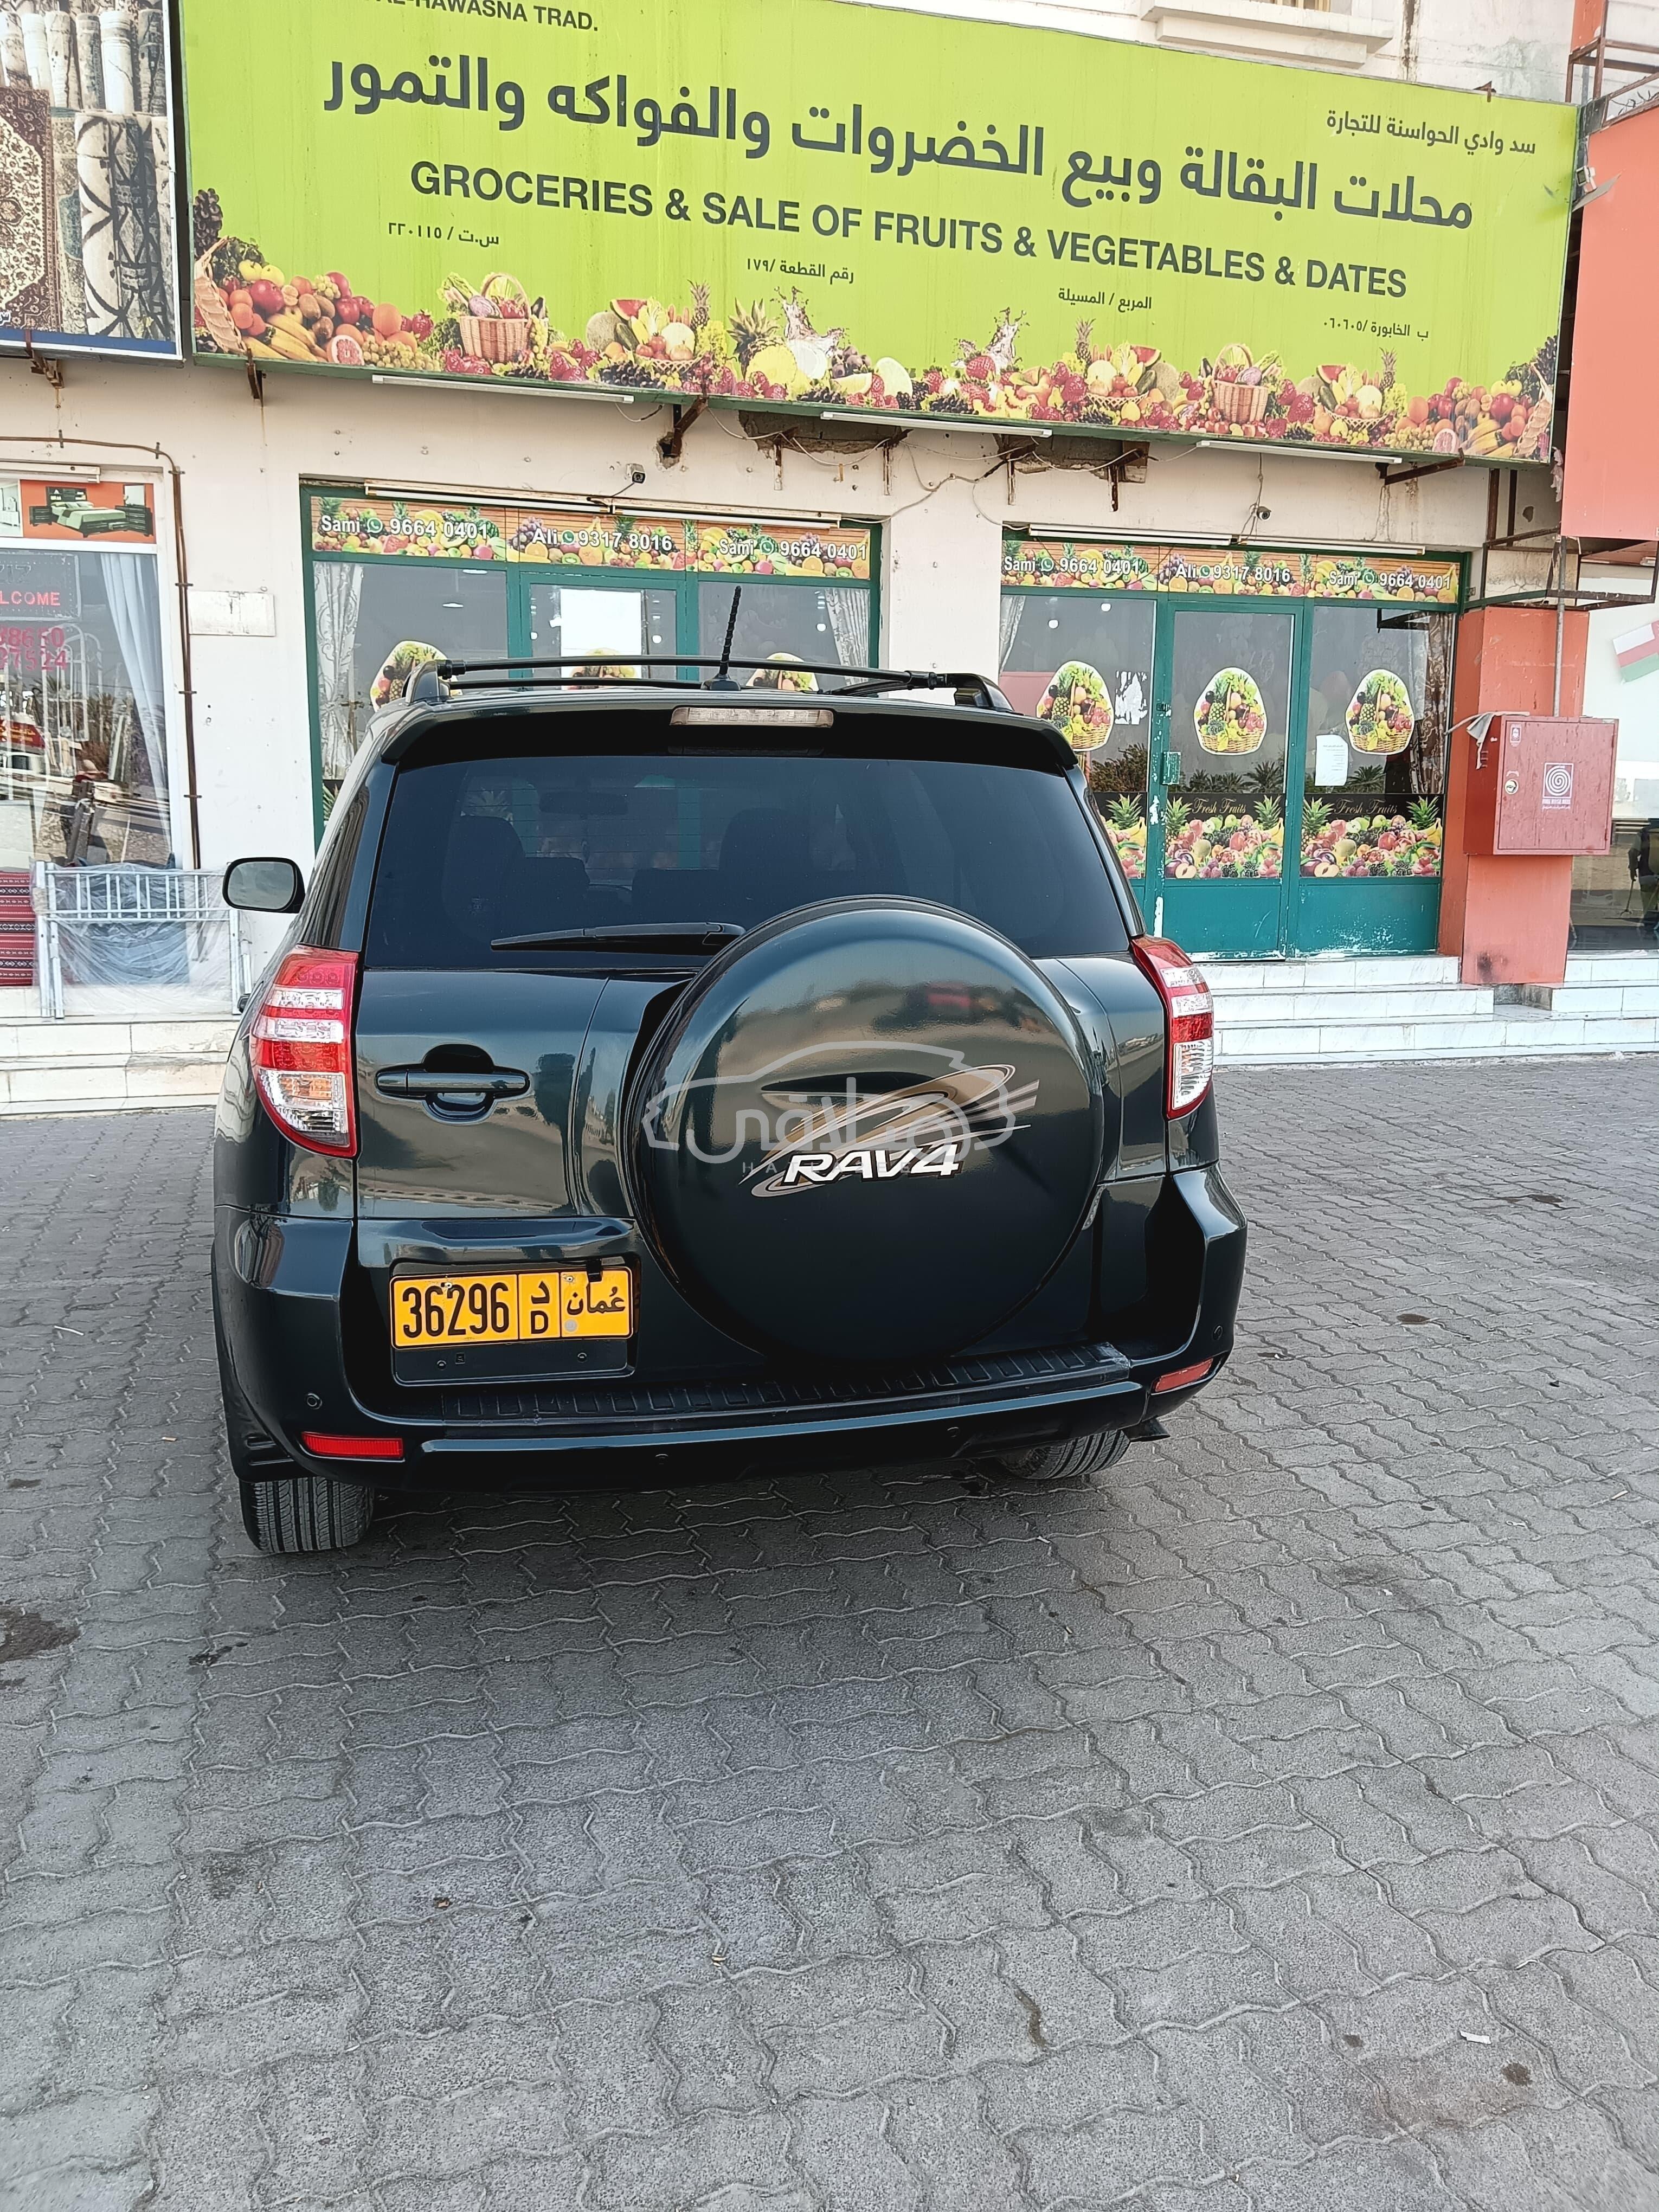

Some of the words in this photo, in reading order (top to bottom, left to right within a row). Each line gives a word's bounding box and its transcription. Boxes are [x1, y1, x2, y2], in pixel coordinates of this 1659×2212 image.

[533, 5, 599, 31] TRAD.
[324, 54, 525, 131] والتمور
[548, 74, 770, 159] والفواكه
[1327, 110, 1381, 137] للتجارة
[792, 104, 1044, 176] الخضروات
[1386, 117, 1459, 147] الحواسنة
[1464, 130, 1504, 156] وادي
[1509, 139, 1536, 155] سد
[1062, 151, 1161, 208] وبيع
[1180, 146, 1317, 221] البقالة
[1334, 176, 1473, 229] محلات
[411, 161, 653, 217] GROCERIES
[665, 188, 691, 221] &
[702, 192, 800, 233] SALE
[812, 204, 862, 237] OF
[874, 210, 1002, 253] FRUITS
[1014, 226, 1037, 257] &
[1047, 229, 1265, 282] VEGETABLES
[1275, 256, 1296, 286] &
[1306, 259, 1406, 298] DATES
[780, 260, 825, 278] القطعة
[829, 267, 854, 285] رقم
[1058, 287, 1105, 305] المسيلة
[1118, 296, 1152, 313] المربع
[1371, 321, 1411, 337] الخابورة
[321, 515, 361, 533] Sami
[390, 517, 436, 537] 9664
[443, 522, 488, 540] 0401
[532, 528, 558, 545] Ali
[578, 530, 622, 548] 9317
[629, 531, 673, 551] 8016
[719, 538, 754, 556] Sami
[780, 540, 821, 558] 9664
[827, 543, 867, 561] 0401
[1004, 556, 1036, 572] Sami
[1060, 557, 1097, 574] 9664
[1103, 559, 1140, 575] 0401
[1175, 564, 1197, 578] Ali
[1213, 565, 1249, 581] 9317
[1255, 566, 1290, 583] 8016
[1329, 570, 1358, 586] Sami
[1380, 572, 1413, 587] 9664
[1418, 575, 1451, 590] 0401
[1193, 798, 1217, 814] Fresh
[1219, 798, 1246, 814] Fruits
[1334, 798, 1363, 814] Fresh
[1368, 798, 1397, 814] Fruits
[781, 1142, 964, 1186] RAV4
[531, 1281, 550, 1304] د
[402, 1282, 510, 1339] 36296
[531, 1310, 549, 1334] D
